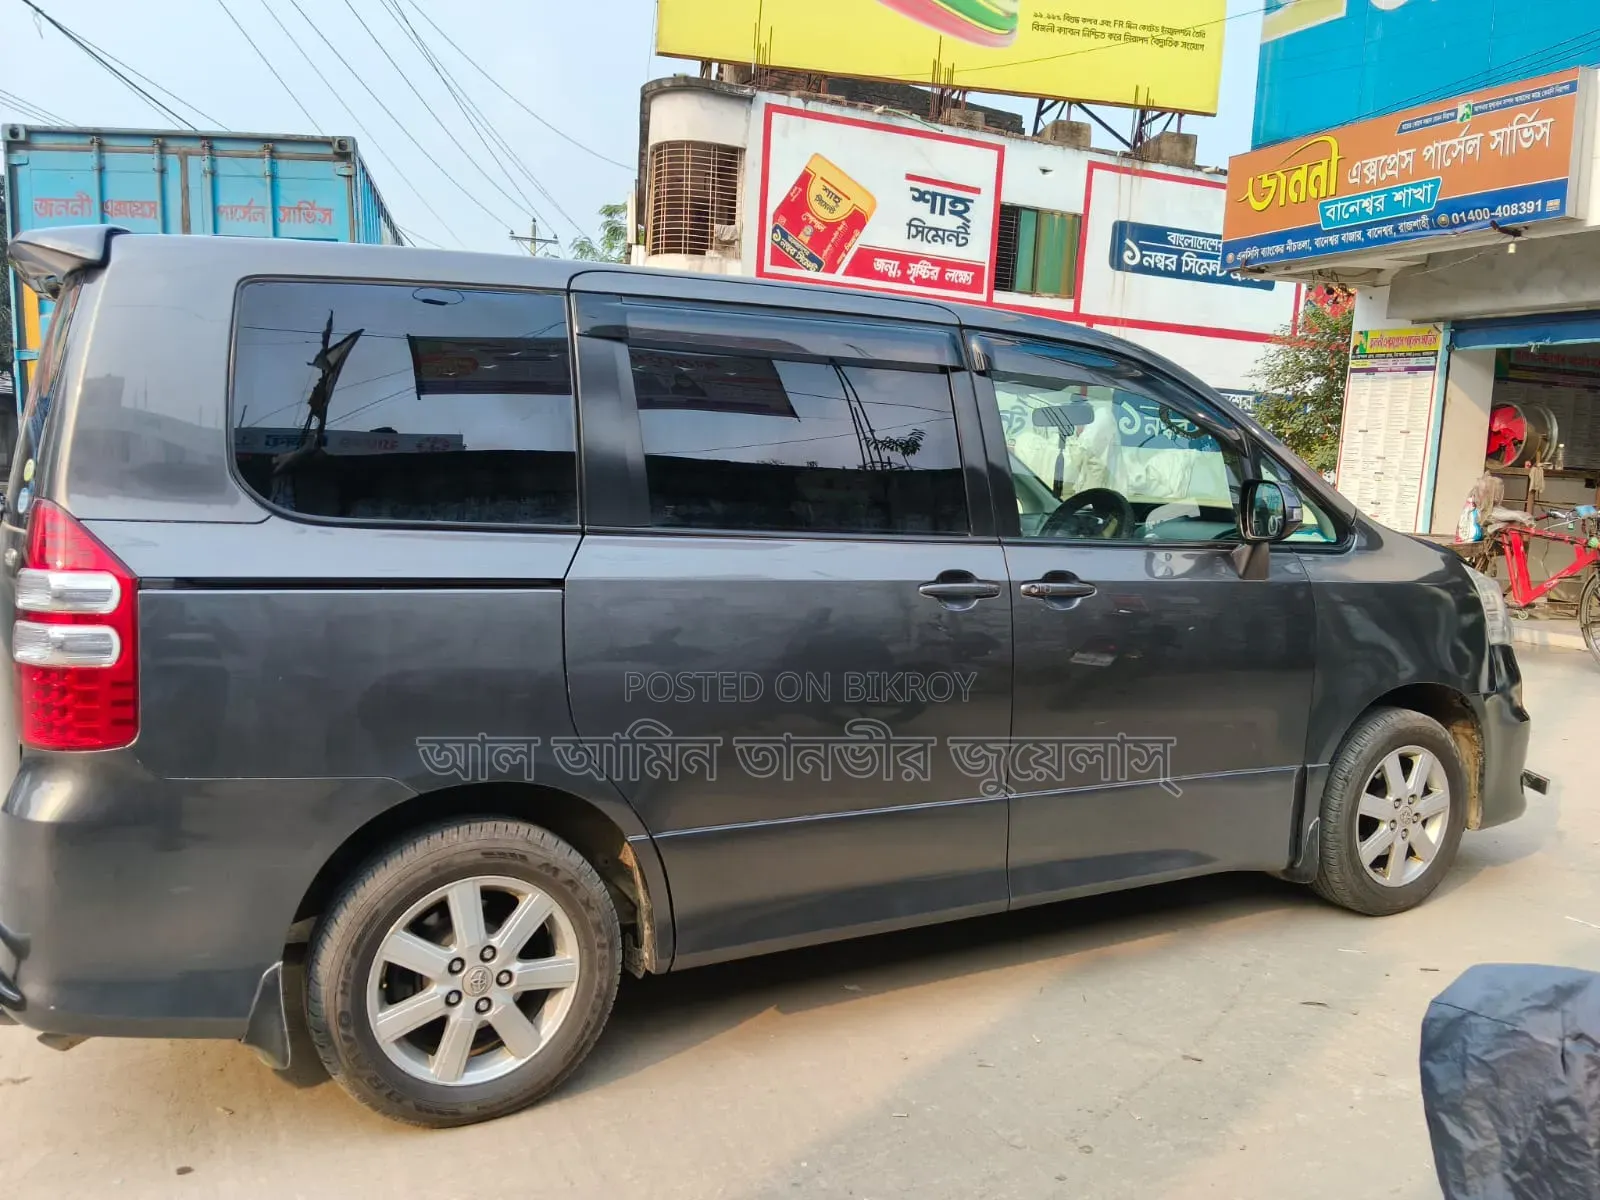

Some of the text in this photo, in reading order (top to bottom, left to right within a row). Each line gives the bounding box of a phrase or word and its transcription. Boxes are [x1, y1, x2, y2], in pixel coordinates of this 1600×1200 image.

[1114, 20, 1124, 28] FR
[1237, 135, 1346, 211] জননী
[1348, 148, 1417, 187] এক্সপ্রেস
[1421, 124, 1485, 170] পার্সেল
[1489, 108, 1555, 160] সার্ভিস
[34, 190, 93, 218] জননী
[278, 199, 334, 226] সার্ভিস
[1325, 182, 1436, 223] বানেশ্বর শাখা
[1452, 199, 1542, 224] 01400-408391
[772, 229, 782, 242] ১
[906, 217, 971, 247] সিমেন্ট
[1314, 233, 1340, 248] বানেশ্বর
[1341, 229, 1364, 243] বাজার,
[1366, 223, 1396, 240] বানেশ্বর,
[1398, 215, 1430, 236] রাজশাহী
[1123, 238, 1141, 266] ১
[1142, 251, 1178, 272] নম্বর
[873, 257, 901, 278] জন্ম,
[907, 260, 941, 284] সৃষ্টির
[1119, 401, 1141, 435] ১
